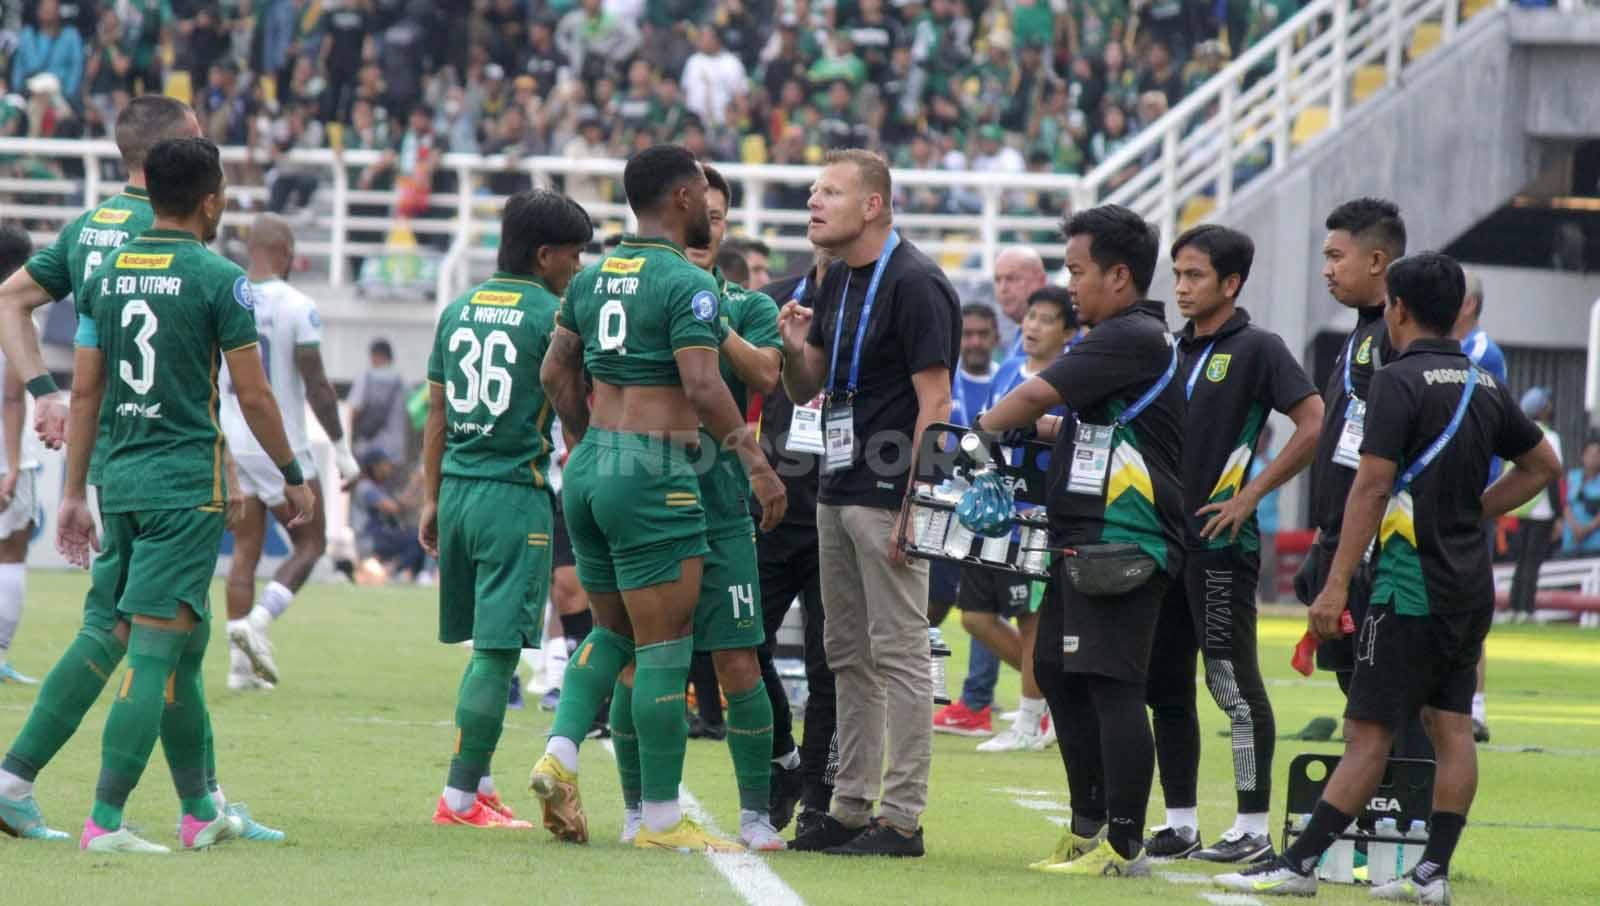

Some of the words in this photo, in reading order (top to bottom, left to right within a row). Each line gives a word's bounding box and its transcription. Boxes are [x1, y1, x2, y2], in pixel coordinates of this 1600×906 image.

[101, 278, 111, 296] R.
[116, 276, 136, 294] ADI
[594, 277, 603, 294] P.
[607, 277, 639, 294] VICTOR
[460, 305, 470, 321] R.
[474, 306, 524, 326] WAHYUDI
[120, 300, 158, 394] 3
[447, 328, 517, 416] 36
[1080, 428, 1091, 441] 14
[728, 584, 754, 618] 14
[1366, 797, 1402, 812] GA
